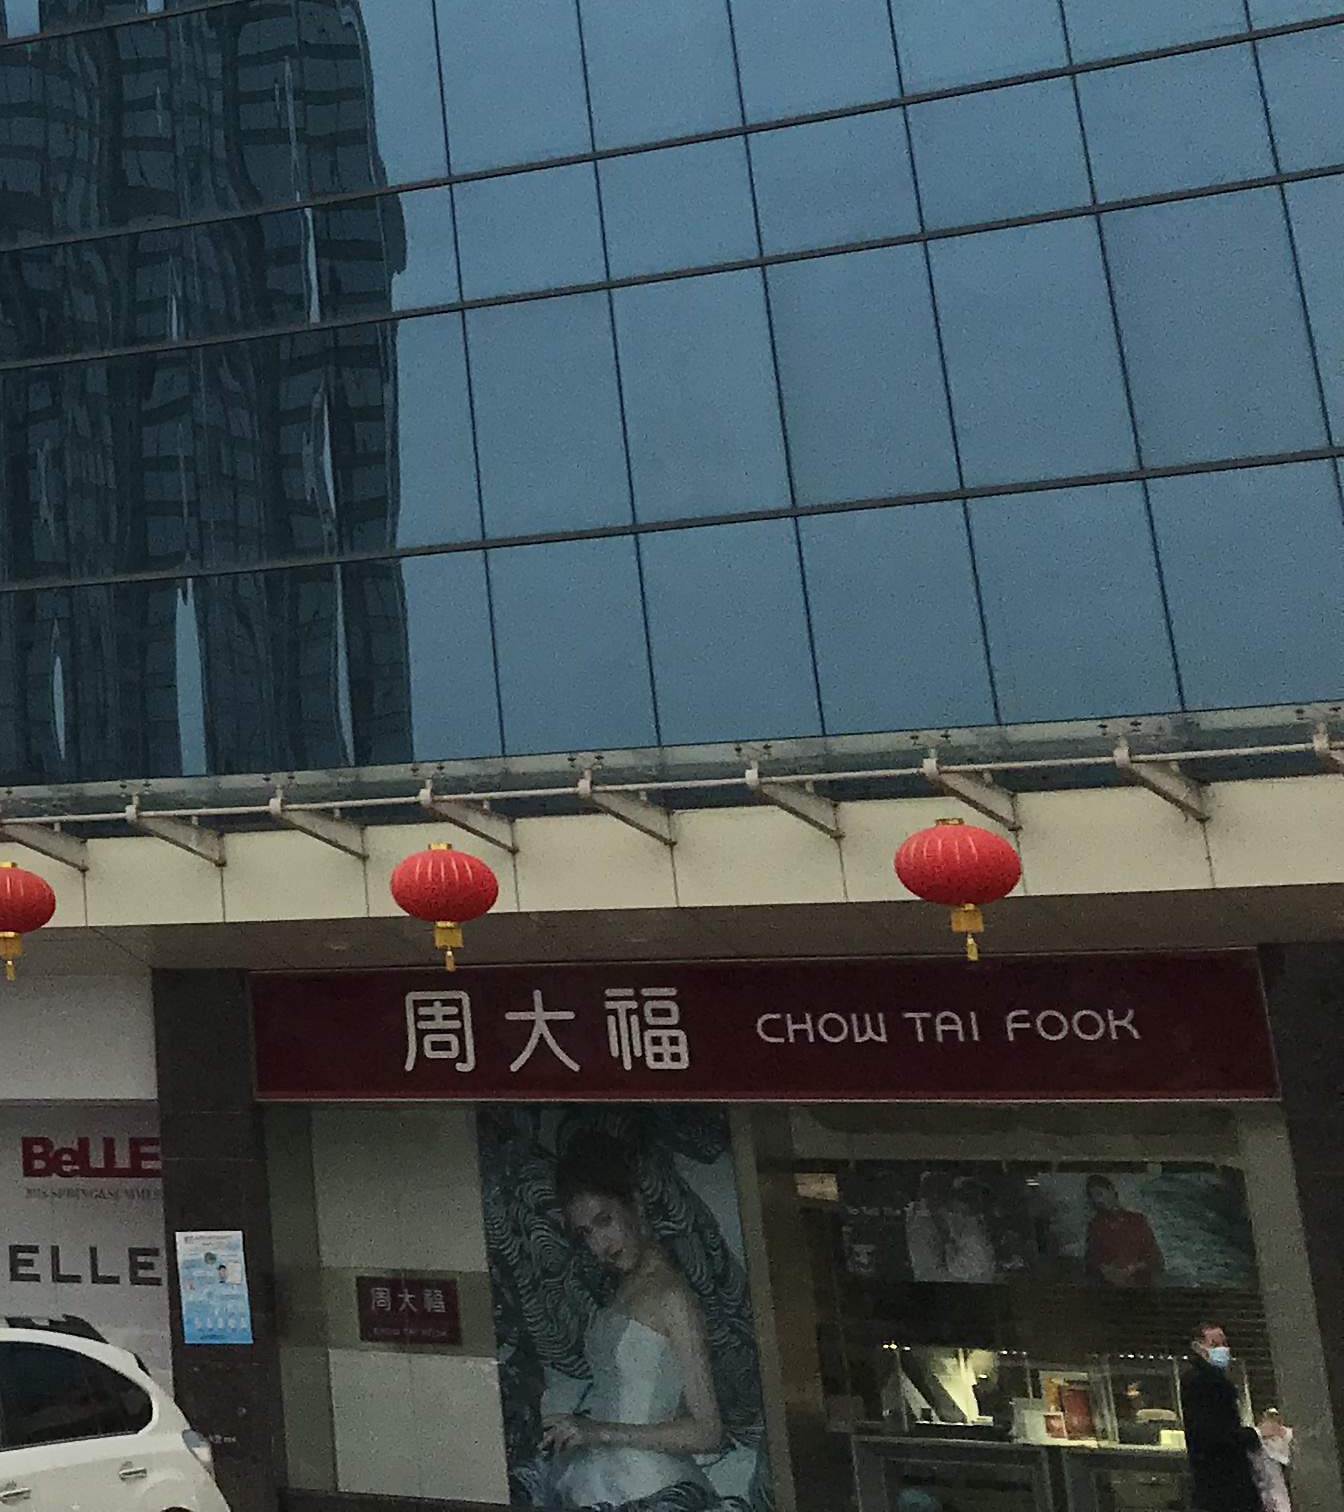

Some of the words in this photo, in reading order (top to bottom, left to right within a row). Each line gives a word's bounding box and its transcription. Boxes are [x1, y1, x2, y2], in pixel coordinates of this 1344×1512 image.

[404, 986, 691, 1073] 周大福
[755, 1011, 889, 1044] CHOW
[902, 1010, 981, 1043] TAI
[1005, 1007, 1142, 1043] FOOK
[370, 1287, 446, 1313] 周大福
